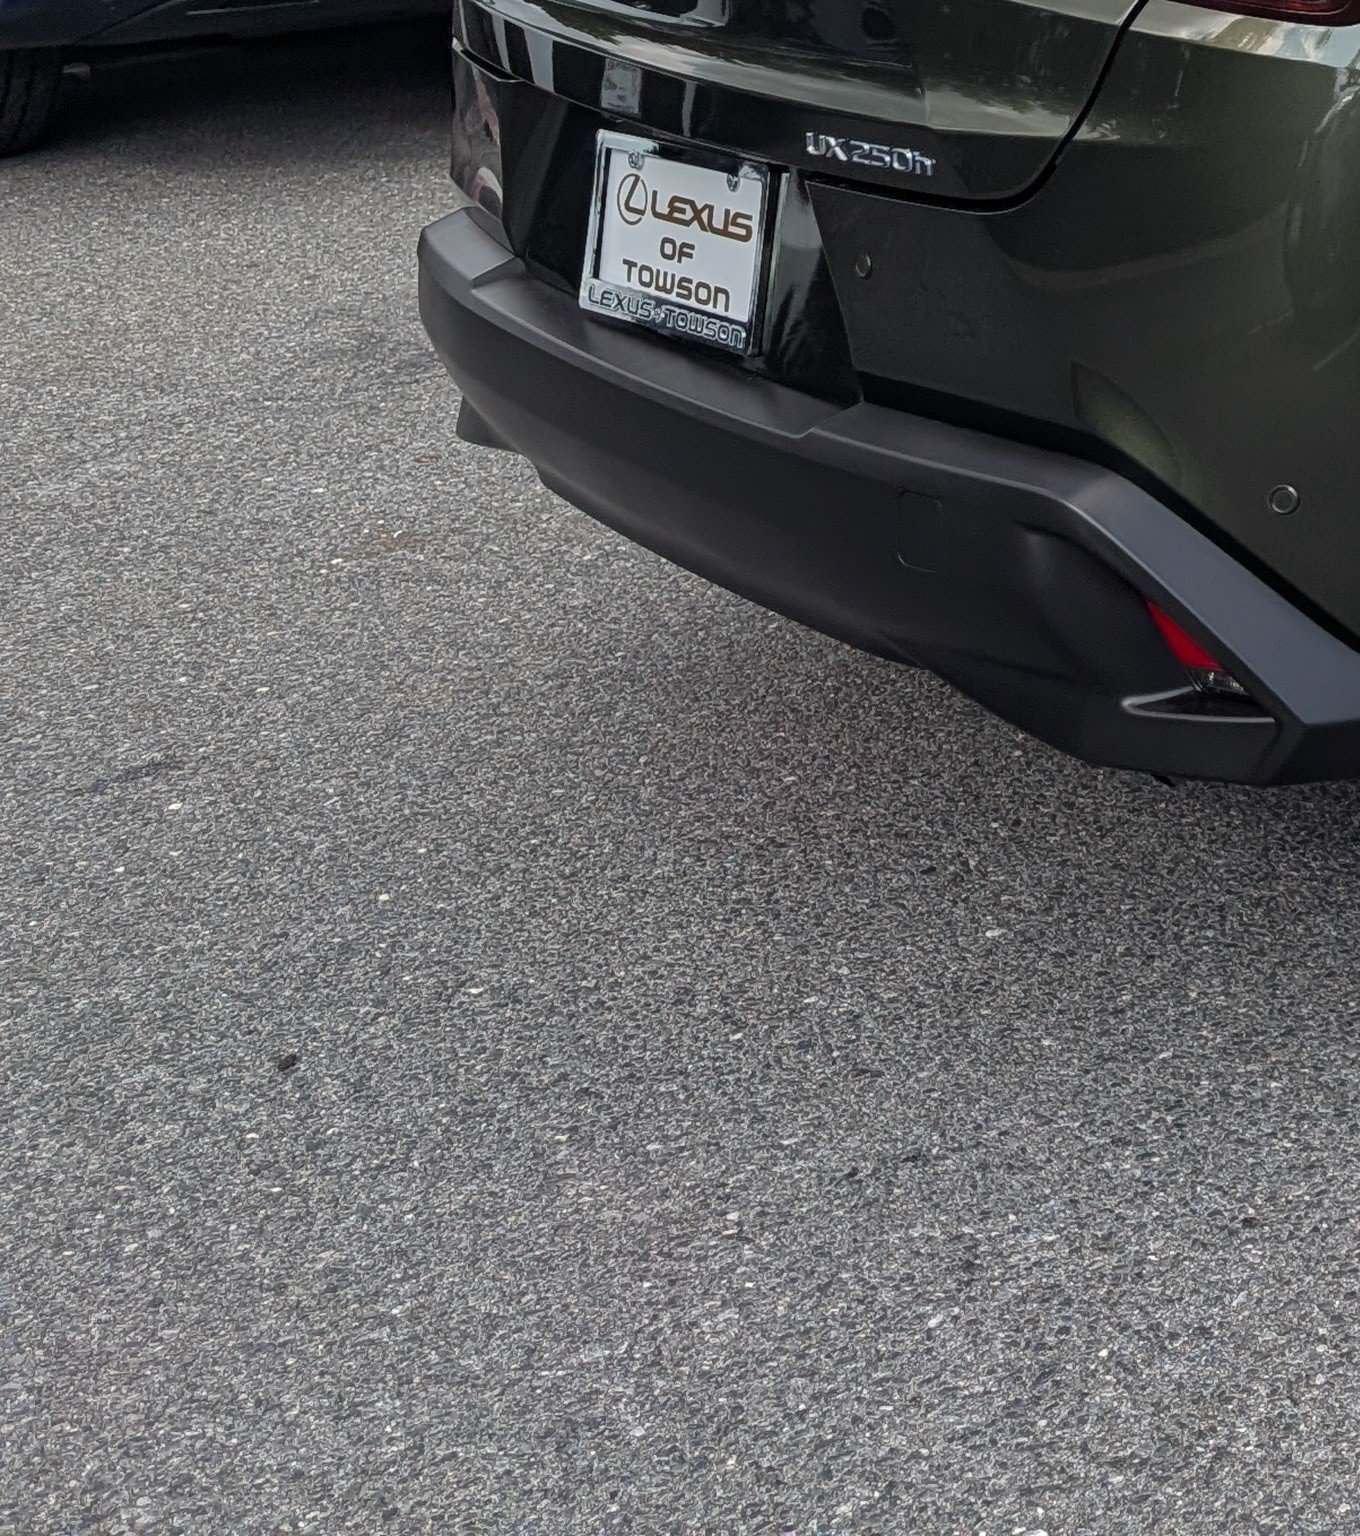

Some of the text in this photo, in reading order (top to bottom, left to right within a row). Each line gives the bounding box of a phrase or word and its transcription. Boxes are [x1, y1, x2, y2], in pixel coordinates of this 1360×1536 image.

[650, 190, 753, 242] LEXUS
[659, 237, 696, 263] OF
[622, 258, 730, 313] TOWSON
[587, 283, 656, 319] LEXUS
[661, 305, 747, 348] TOWSON
